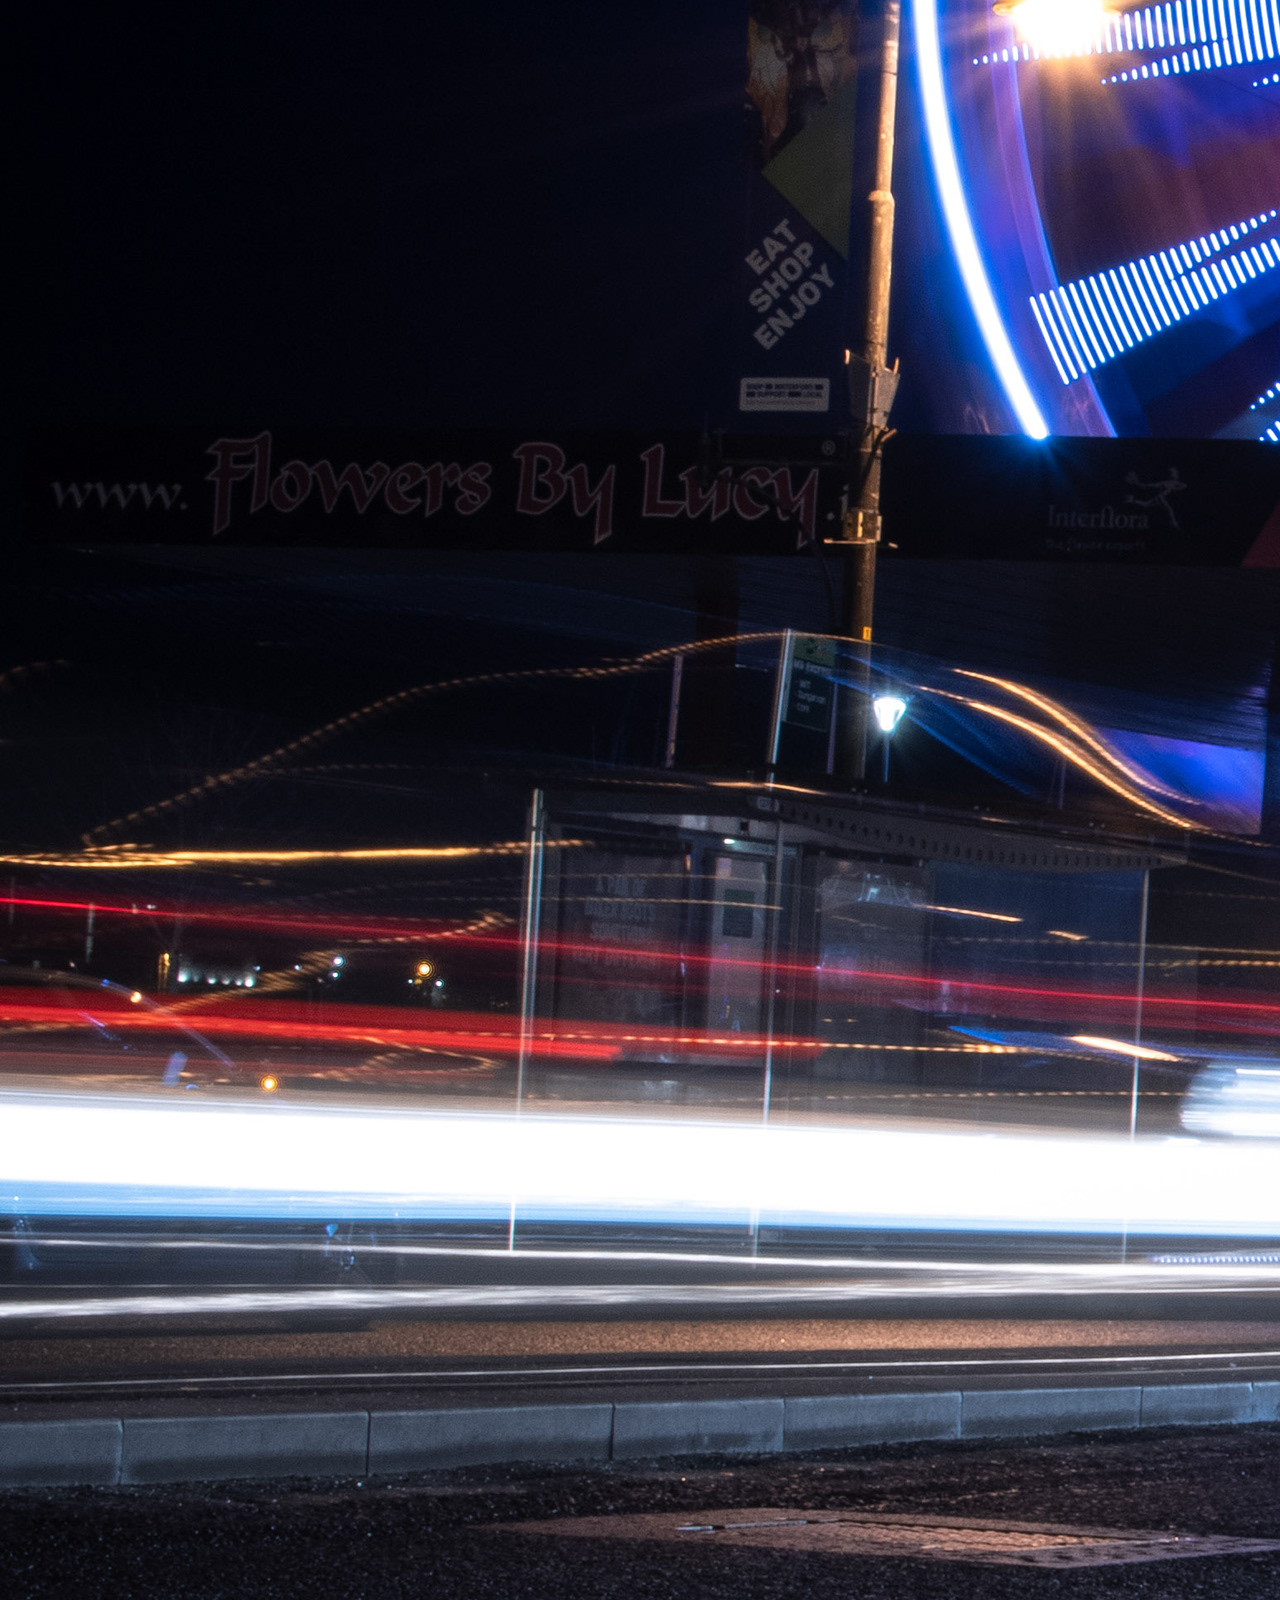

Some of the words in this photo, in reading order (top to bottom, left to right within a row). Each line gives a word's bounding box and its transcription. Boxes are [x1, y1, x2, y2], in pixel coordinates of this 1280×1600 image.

[744, 218, 796, 276] EAT
[747, 242, 814, 314] SHOP
[751, 261, 836, 351] ENJOY
[49, 480, 188, 510] www.
[205, 430, 492, 537] Flowers
[512, 441, 616, 546] By
[1047, 504, 1149, 530] Interflora
